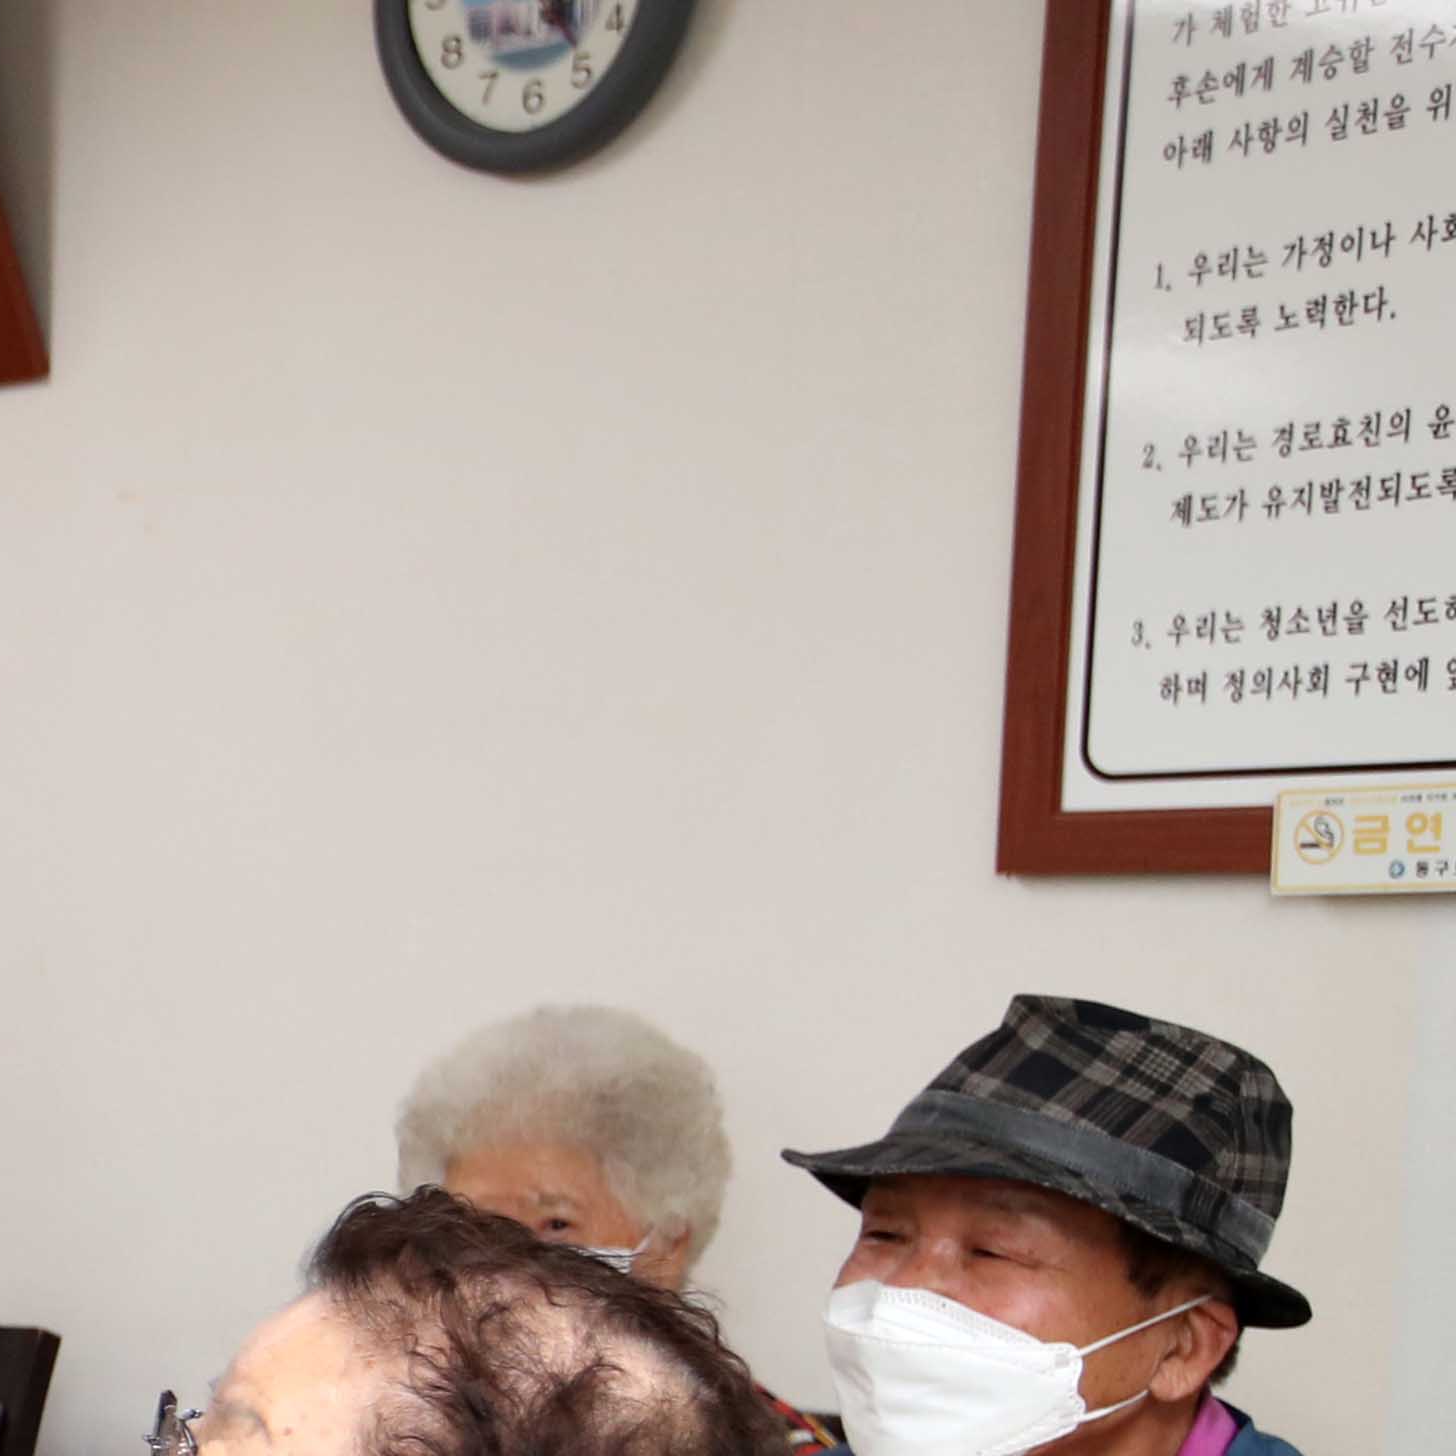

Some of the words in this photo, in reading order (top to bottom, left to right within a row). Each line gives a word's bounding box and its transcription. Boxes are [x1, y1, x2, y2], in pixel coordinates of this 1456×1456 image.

[1173, 12, 1198, 47] 가
[1210, 0, 1288, 39] 체험한
[441, 34, 464, 69] 8
[571, 53, 592, 89] 5
[1168, 56, 1275, 110] 후손에게
[1289, 36, 1375, 84] 계승할
[1390, 23, 1456, 66] 전수
[479, 71, 500, 104] 7
[522, 79, 545, 115] 6
[1163, 129, 1214, 168] 아래
[1228, 110, 1310, 157] 사항의
[1325, 92, 1412, 142] 실천을
[1153, 263, 1172, 292] 1.
[1188, 246, 1269, 286] 우리는
[1282, 221, 1397, 271] 가정이나
[1183, 305, 1261, 345] 되도록
[1274, 285, 1397, 332] 노력한다.
[1142, 443, 1163, 471] 2.
[1178, 429, 1259, 467] 우리는
[1271, 407, 1411, 459] 경로효친의
[1170, 487, 1249, 528] 제도가
[1131, 619, 1152, 650] 3.
[1167, 609, 1246, 647] 우리는
[1260, 599, 1370, 643] 청소년을
[1160, 671, 1209, 706] 하며
[1223, 663, 1330, 704] 정의사회
[1345, 656, 1430, 697] 구현에
